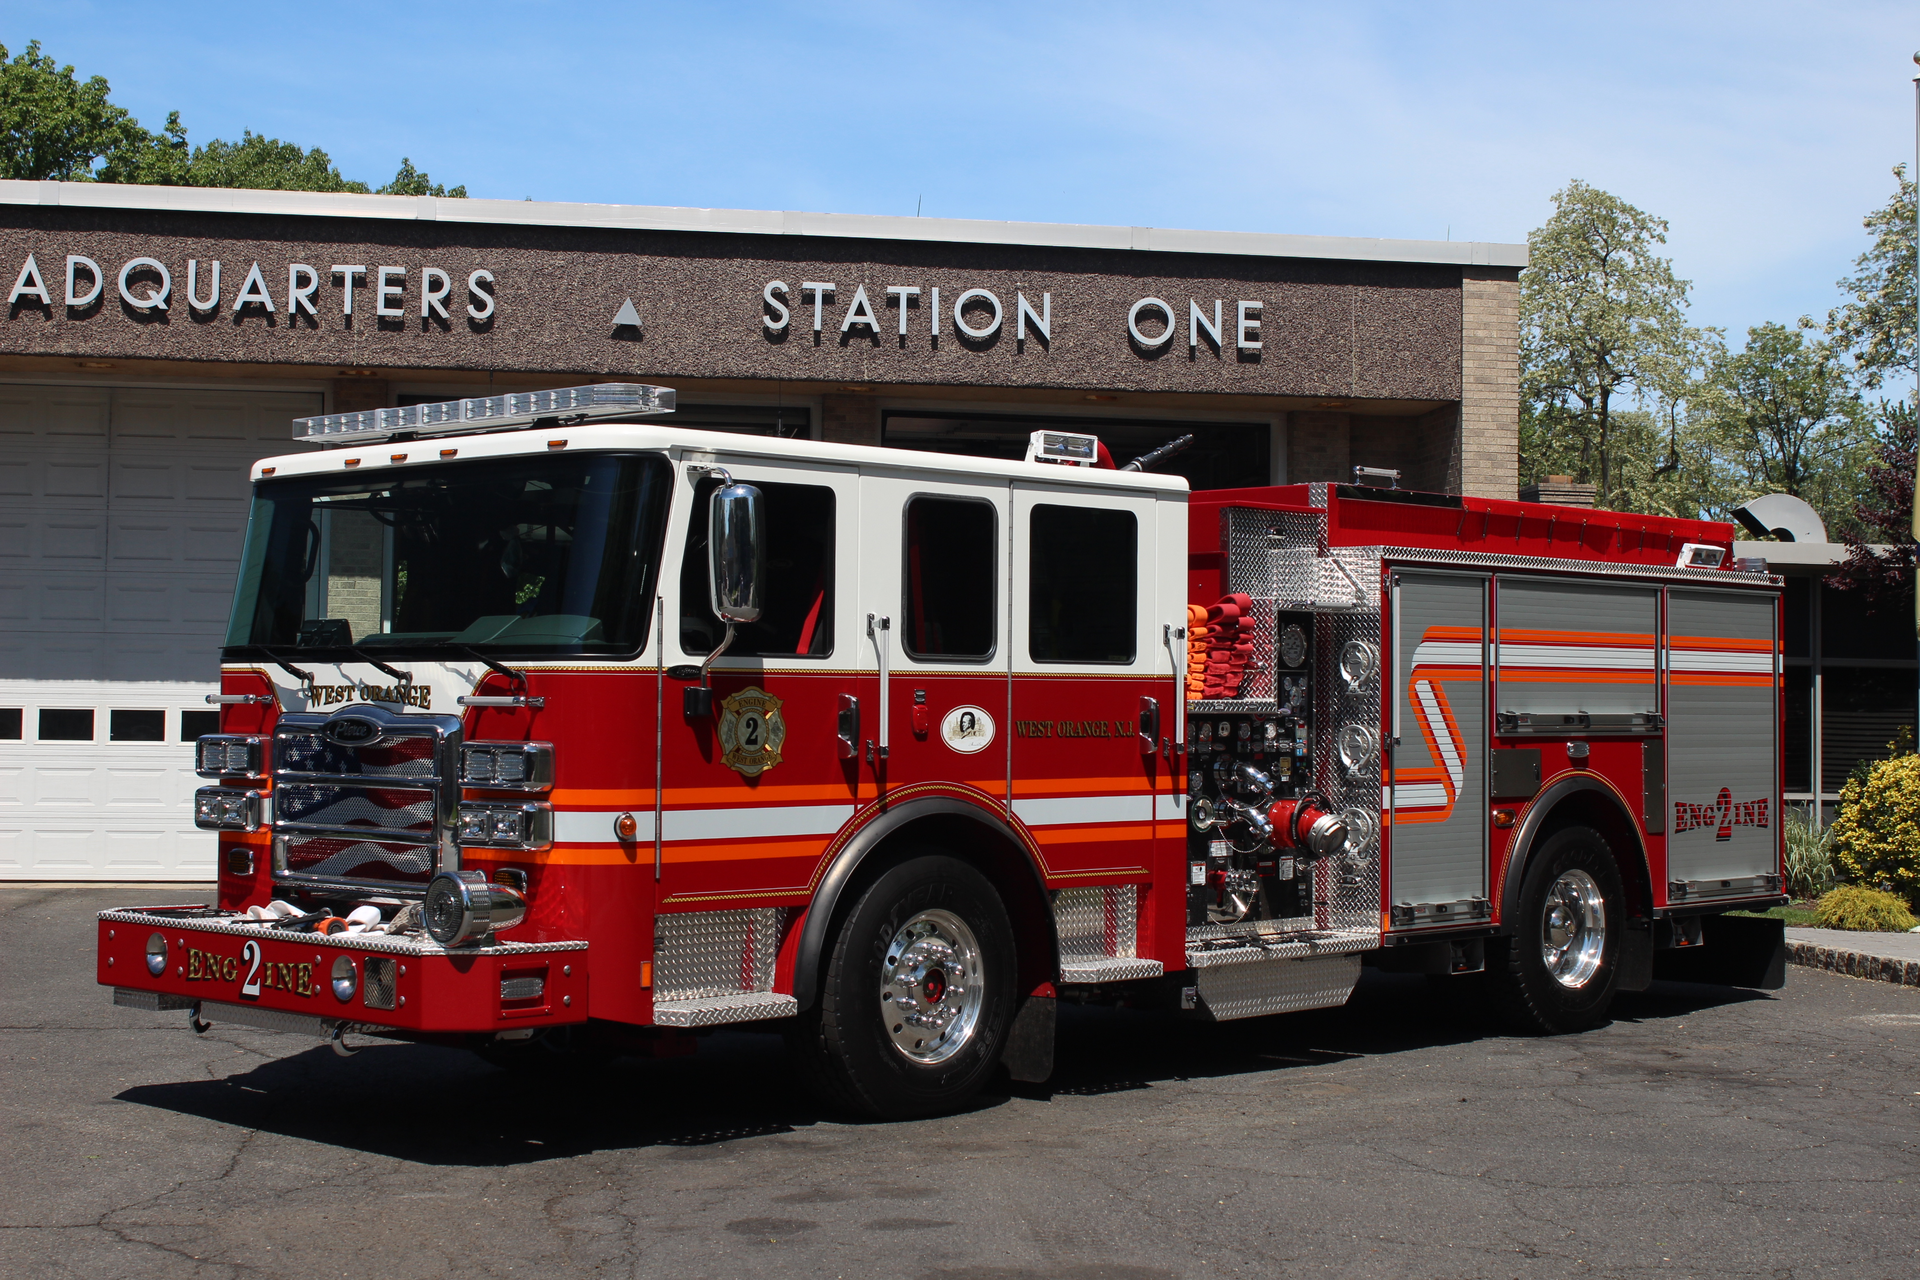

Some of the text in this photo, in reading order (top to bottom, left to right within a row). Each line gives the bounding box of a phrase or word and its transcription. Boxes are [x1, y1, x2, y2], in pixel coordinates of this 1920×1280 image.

[8, 253, 1264, 351] ADQUARTERS STATION ONE
[310, 685, 431, 710] WEST ORANGE
[738, 698, 767, 708] ENGINE
[745, 717, 758, 745] 2
[1016, 720, 1053, 738] WEST
